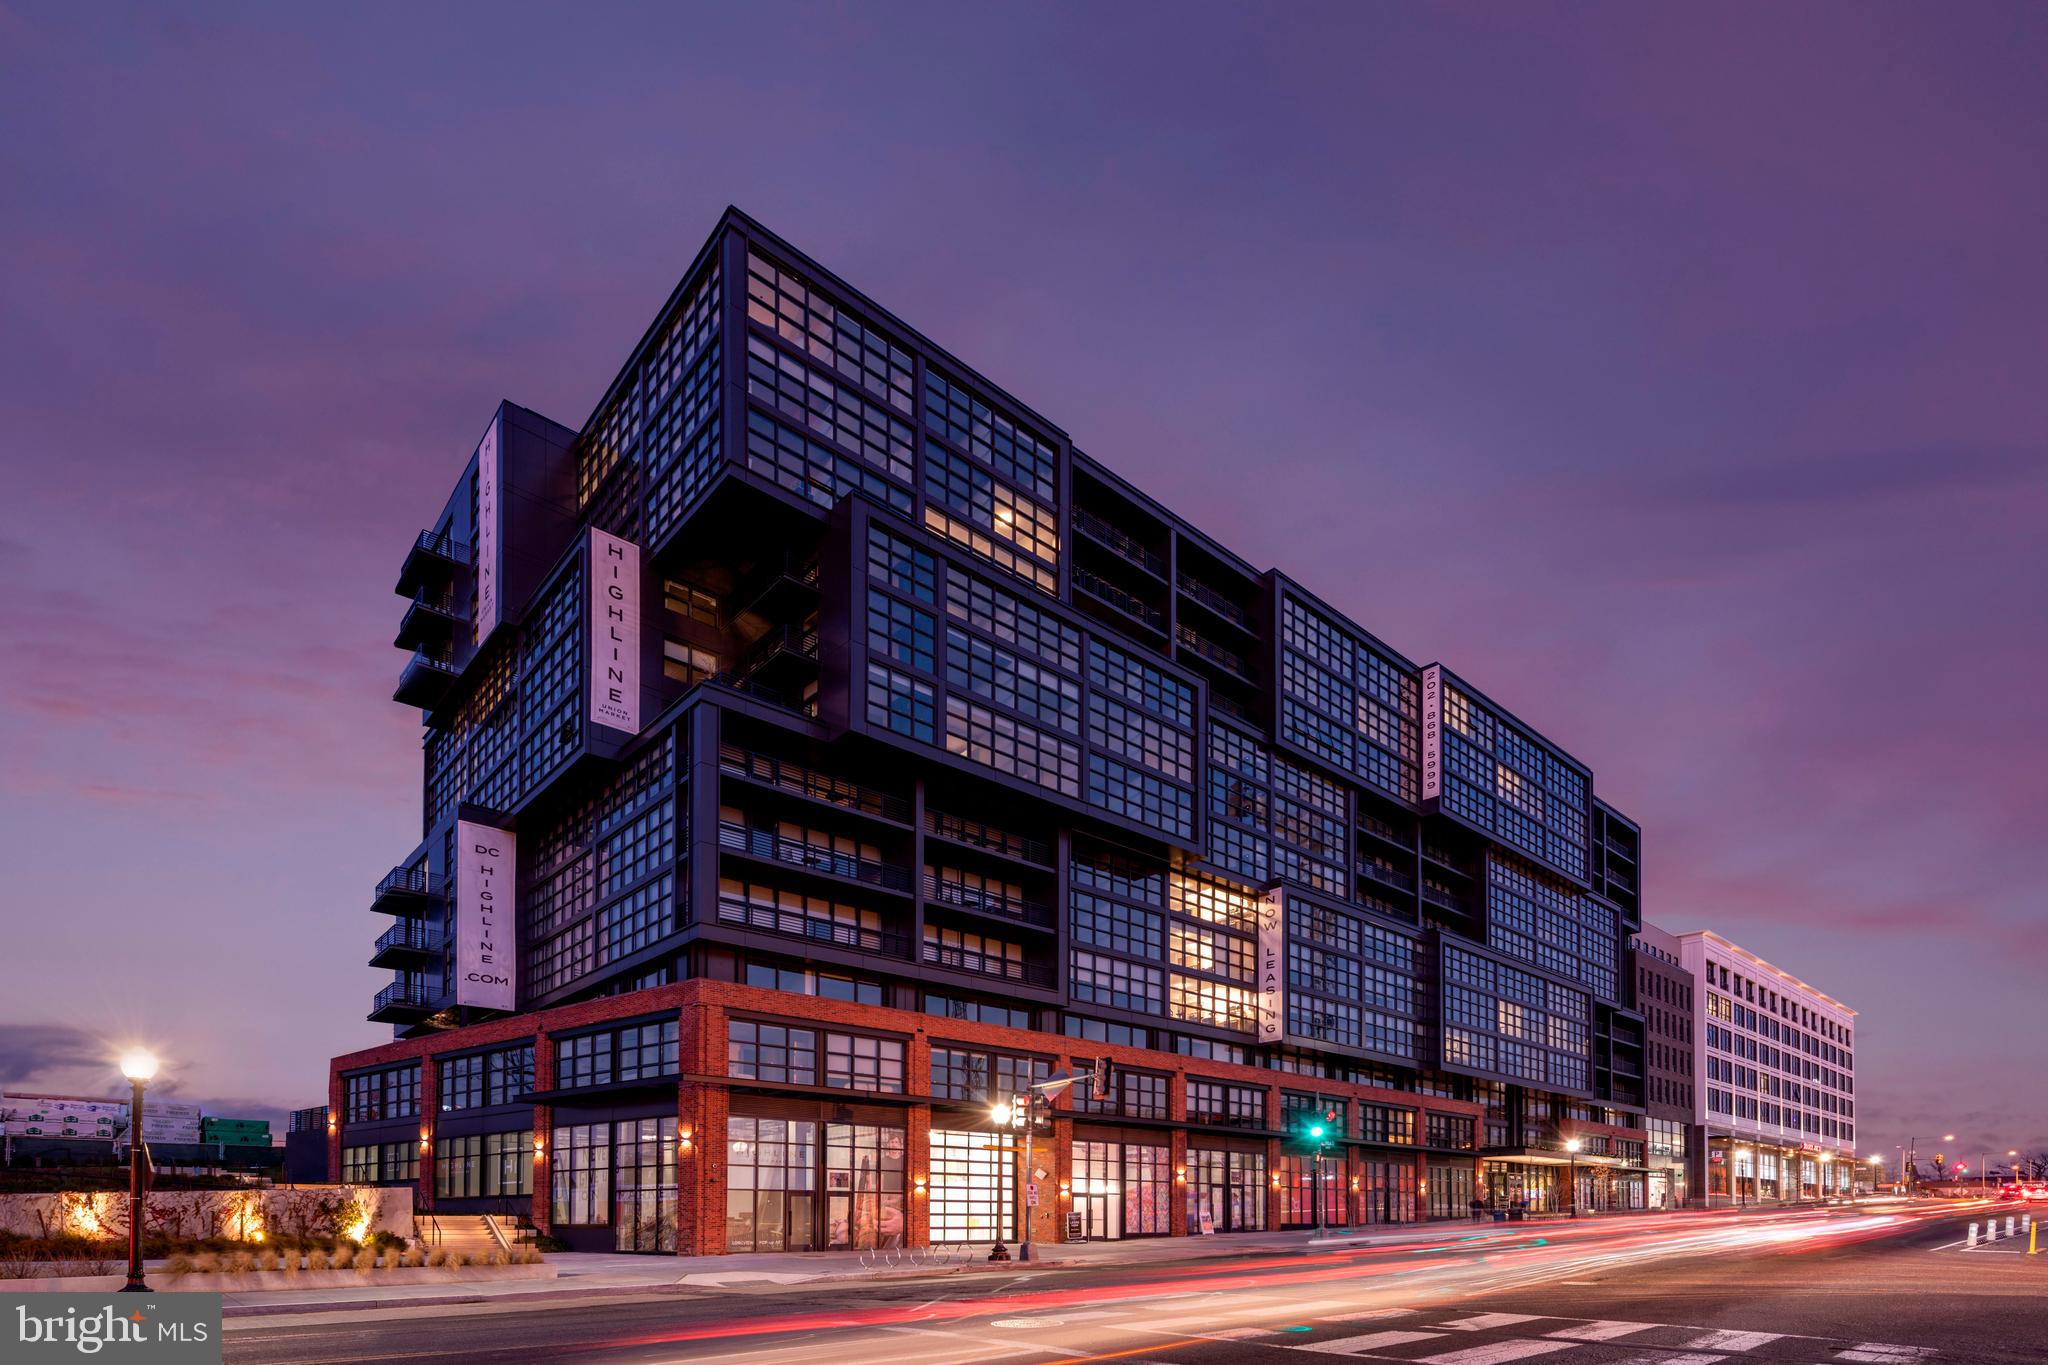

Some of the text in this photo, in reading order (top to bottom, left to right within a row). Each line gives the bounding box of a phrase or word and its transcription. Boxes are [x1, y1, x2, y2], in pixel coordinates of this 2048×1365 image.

[608, 543, 623, 703] HIGHLINE
[598, 708, 631, 721] MARKET
[601, 704, 628, 716] UNION
[475, 845, 500, 857] DC
[480, 865, 493, 964] HIGHLINE
[1264, 895, 1277, 1033] NOW LEASING
[464, 973, 508, 986] .COM
